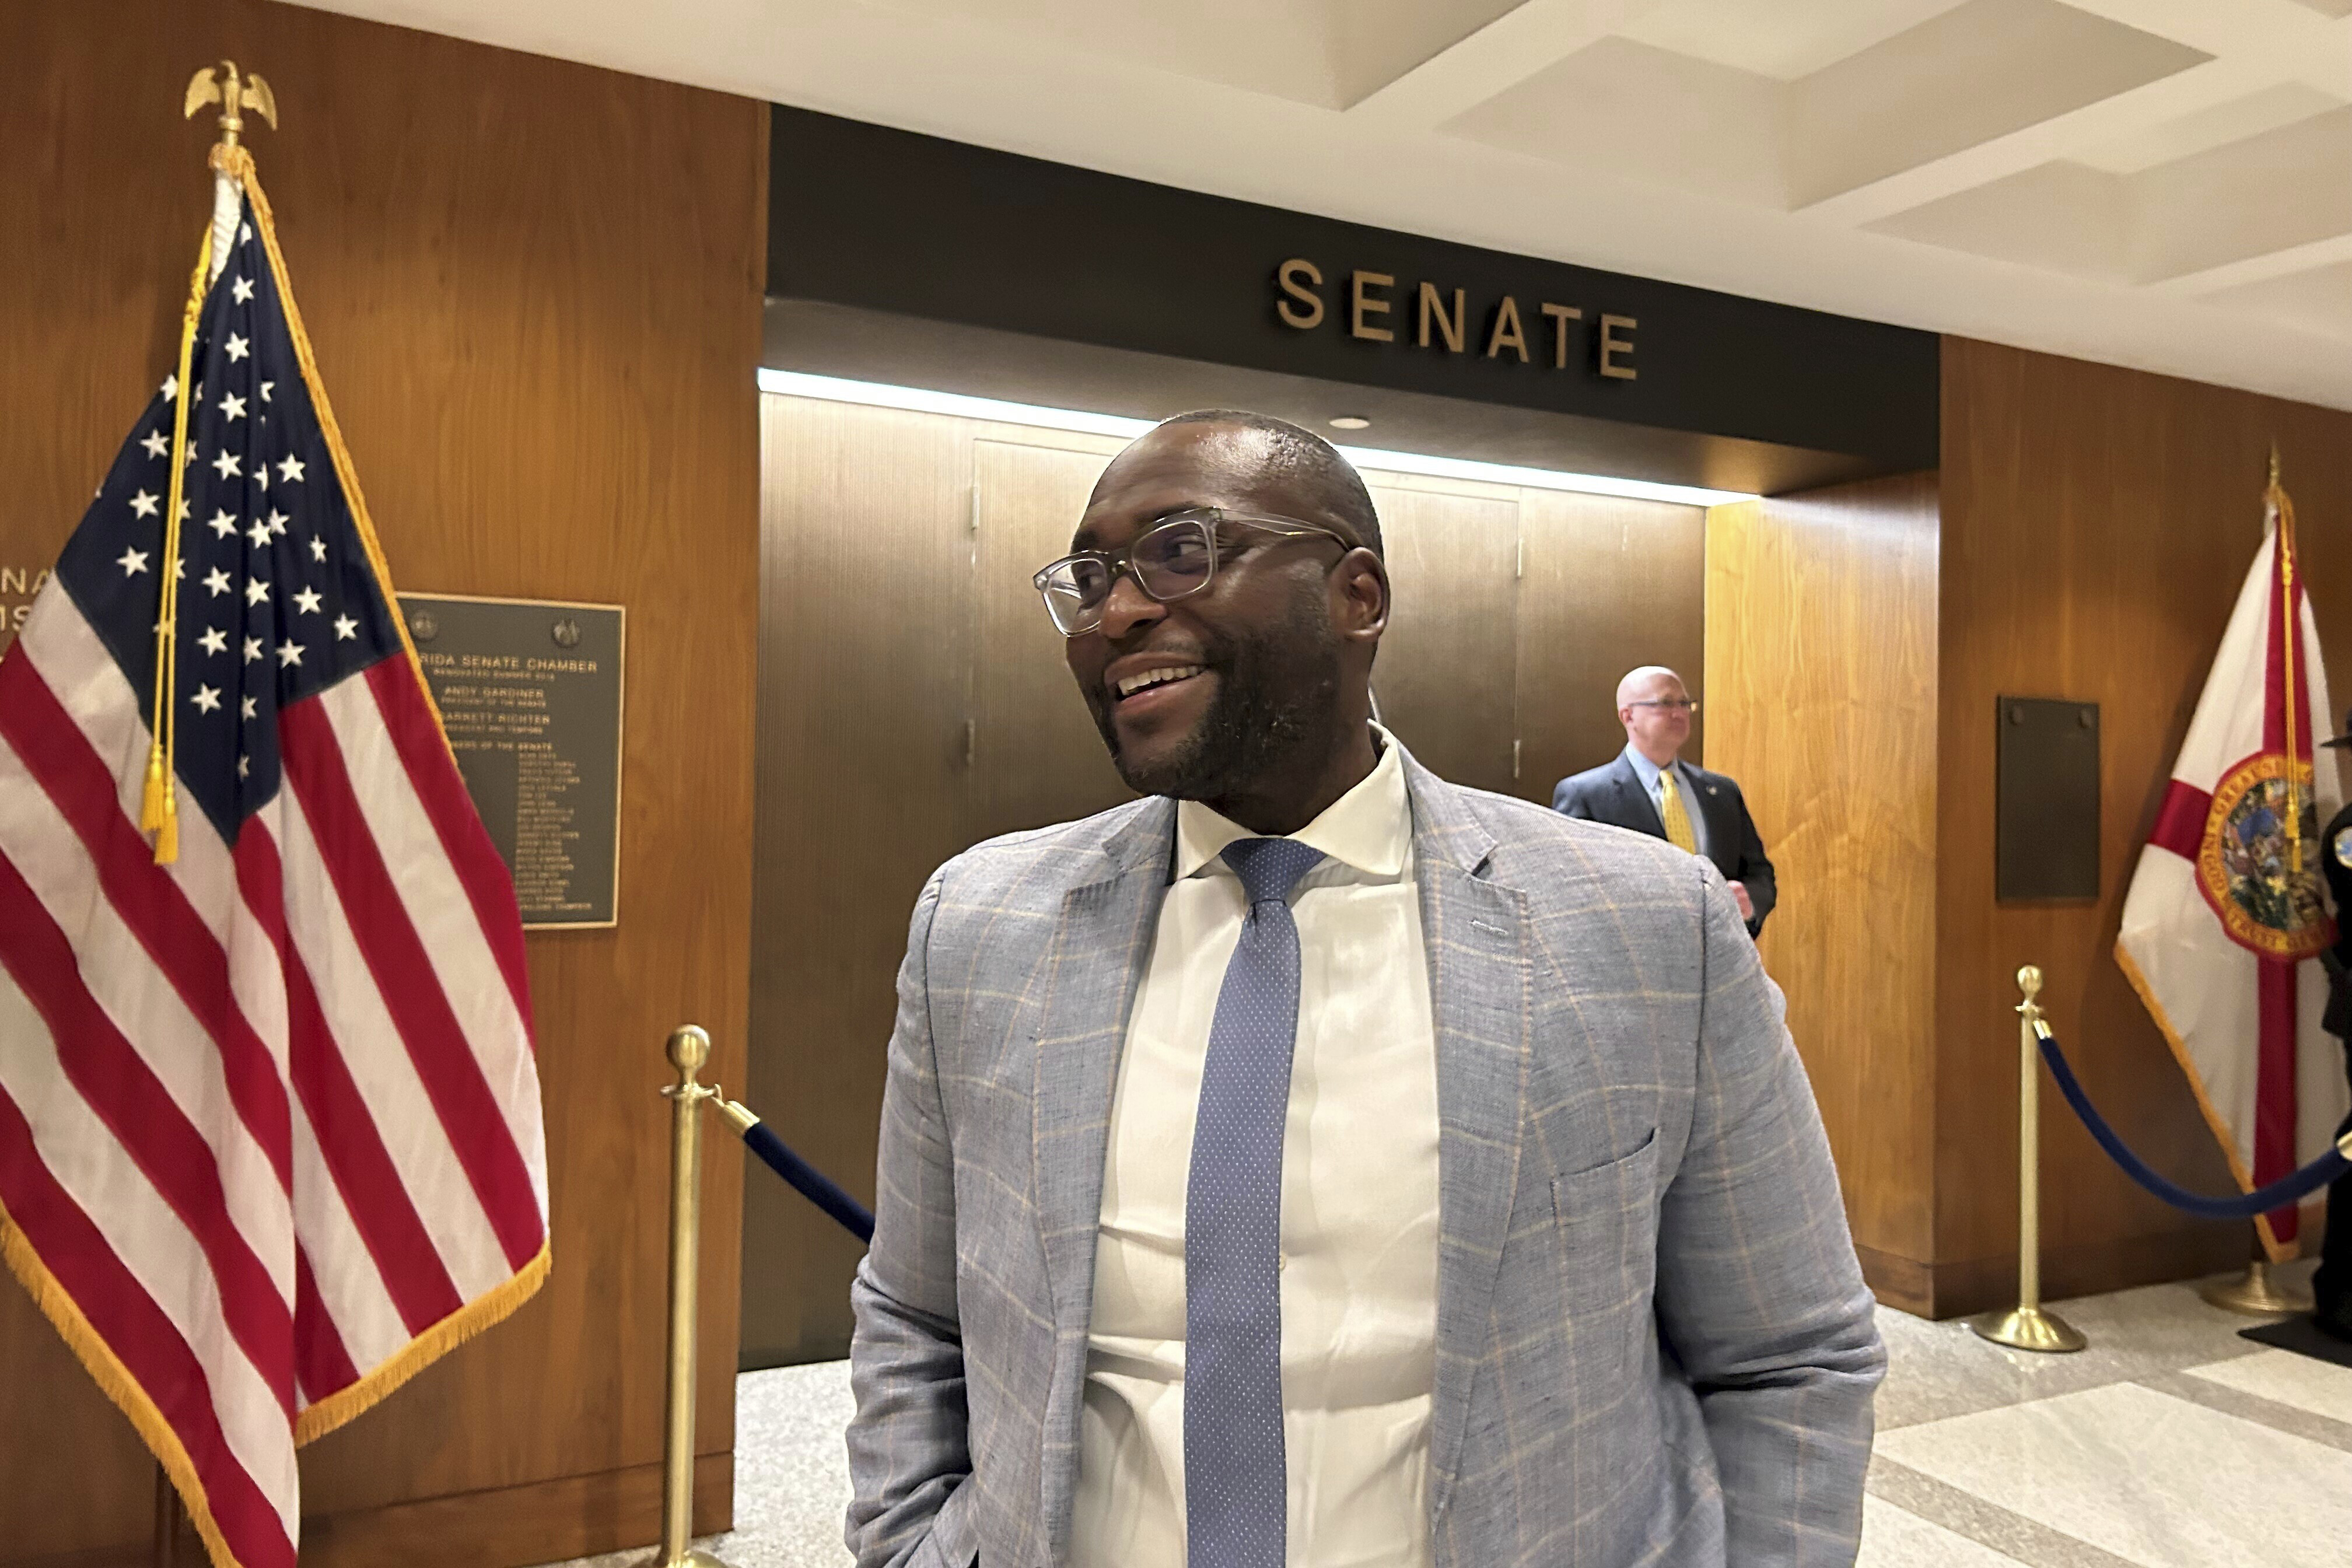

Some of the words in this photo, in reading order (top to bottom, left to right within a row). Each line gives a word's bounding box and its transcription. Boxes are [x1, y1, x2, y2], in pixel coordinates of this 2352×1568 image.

[1276, 258, 1637, 380] SENATE
[462, 653, 520, 670] SENATE
[526, 657, 598, 674] CHAMBER
